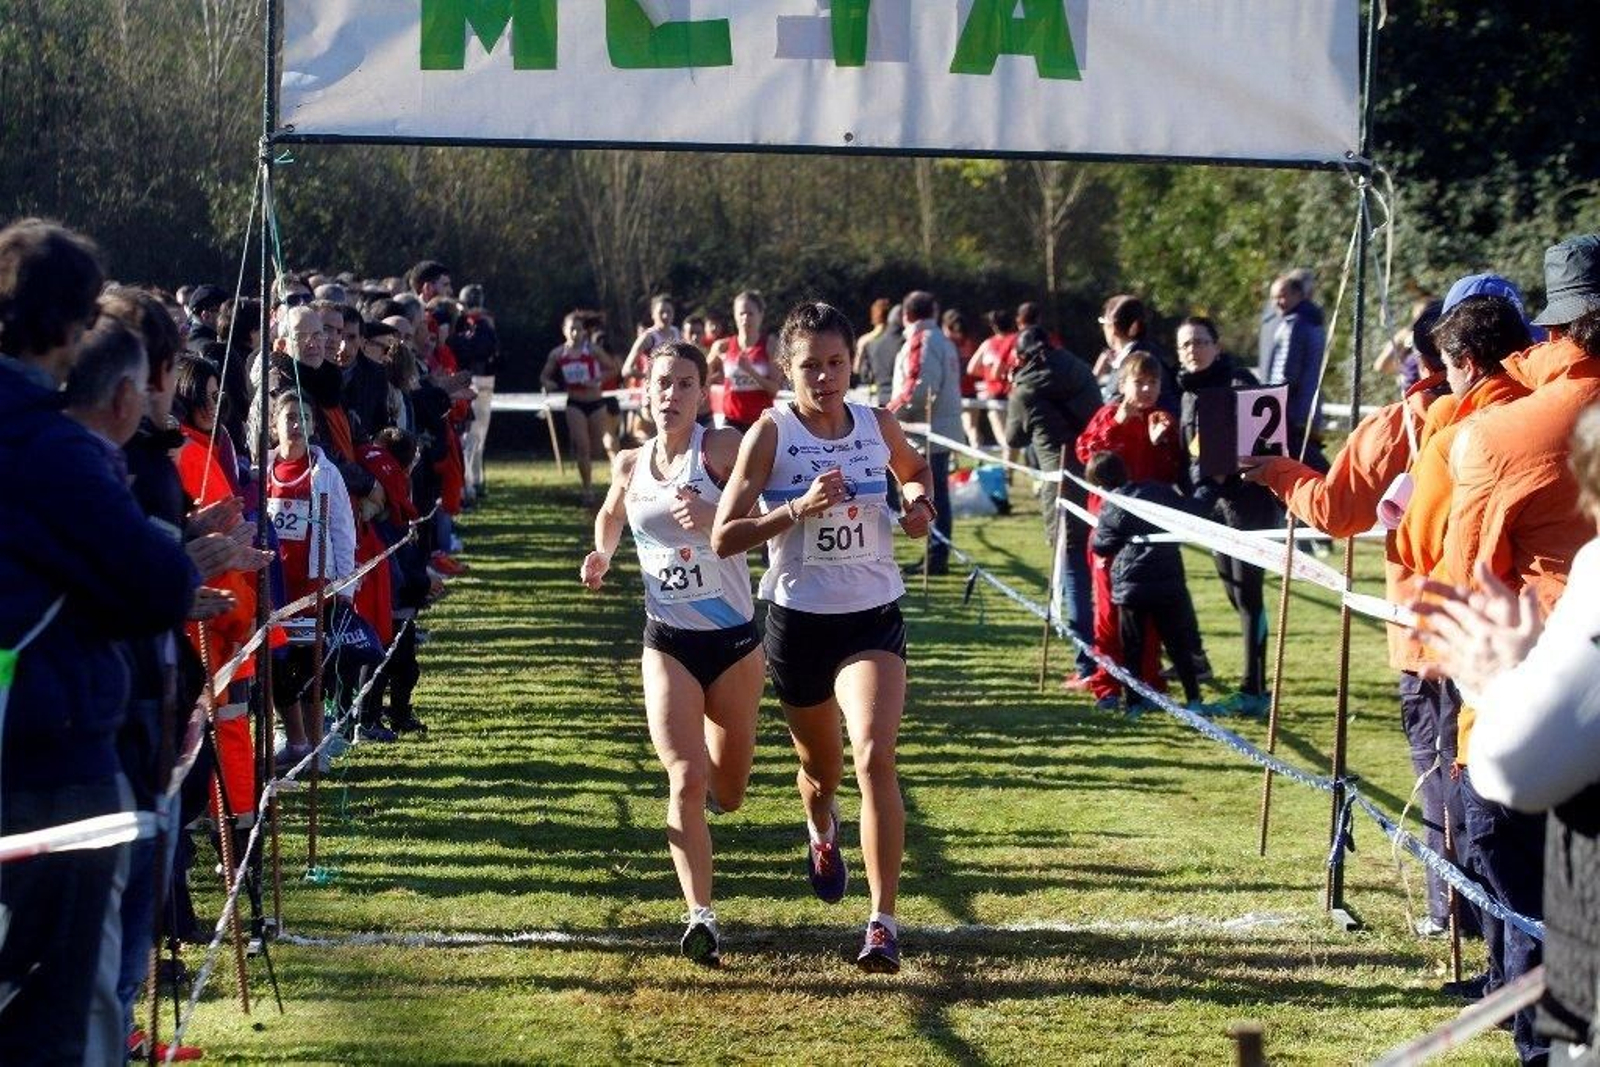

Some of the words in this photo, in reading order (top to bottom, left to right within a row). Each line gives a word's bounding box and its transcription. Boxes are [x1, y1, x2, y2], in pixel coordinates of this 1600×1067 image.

[1251, 395, 1282, 456] 2
[816, 522, 865, 552] 501
[658, 564, 703, 592] 231
